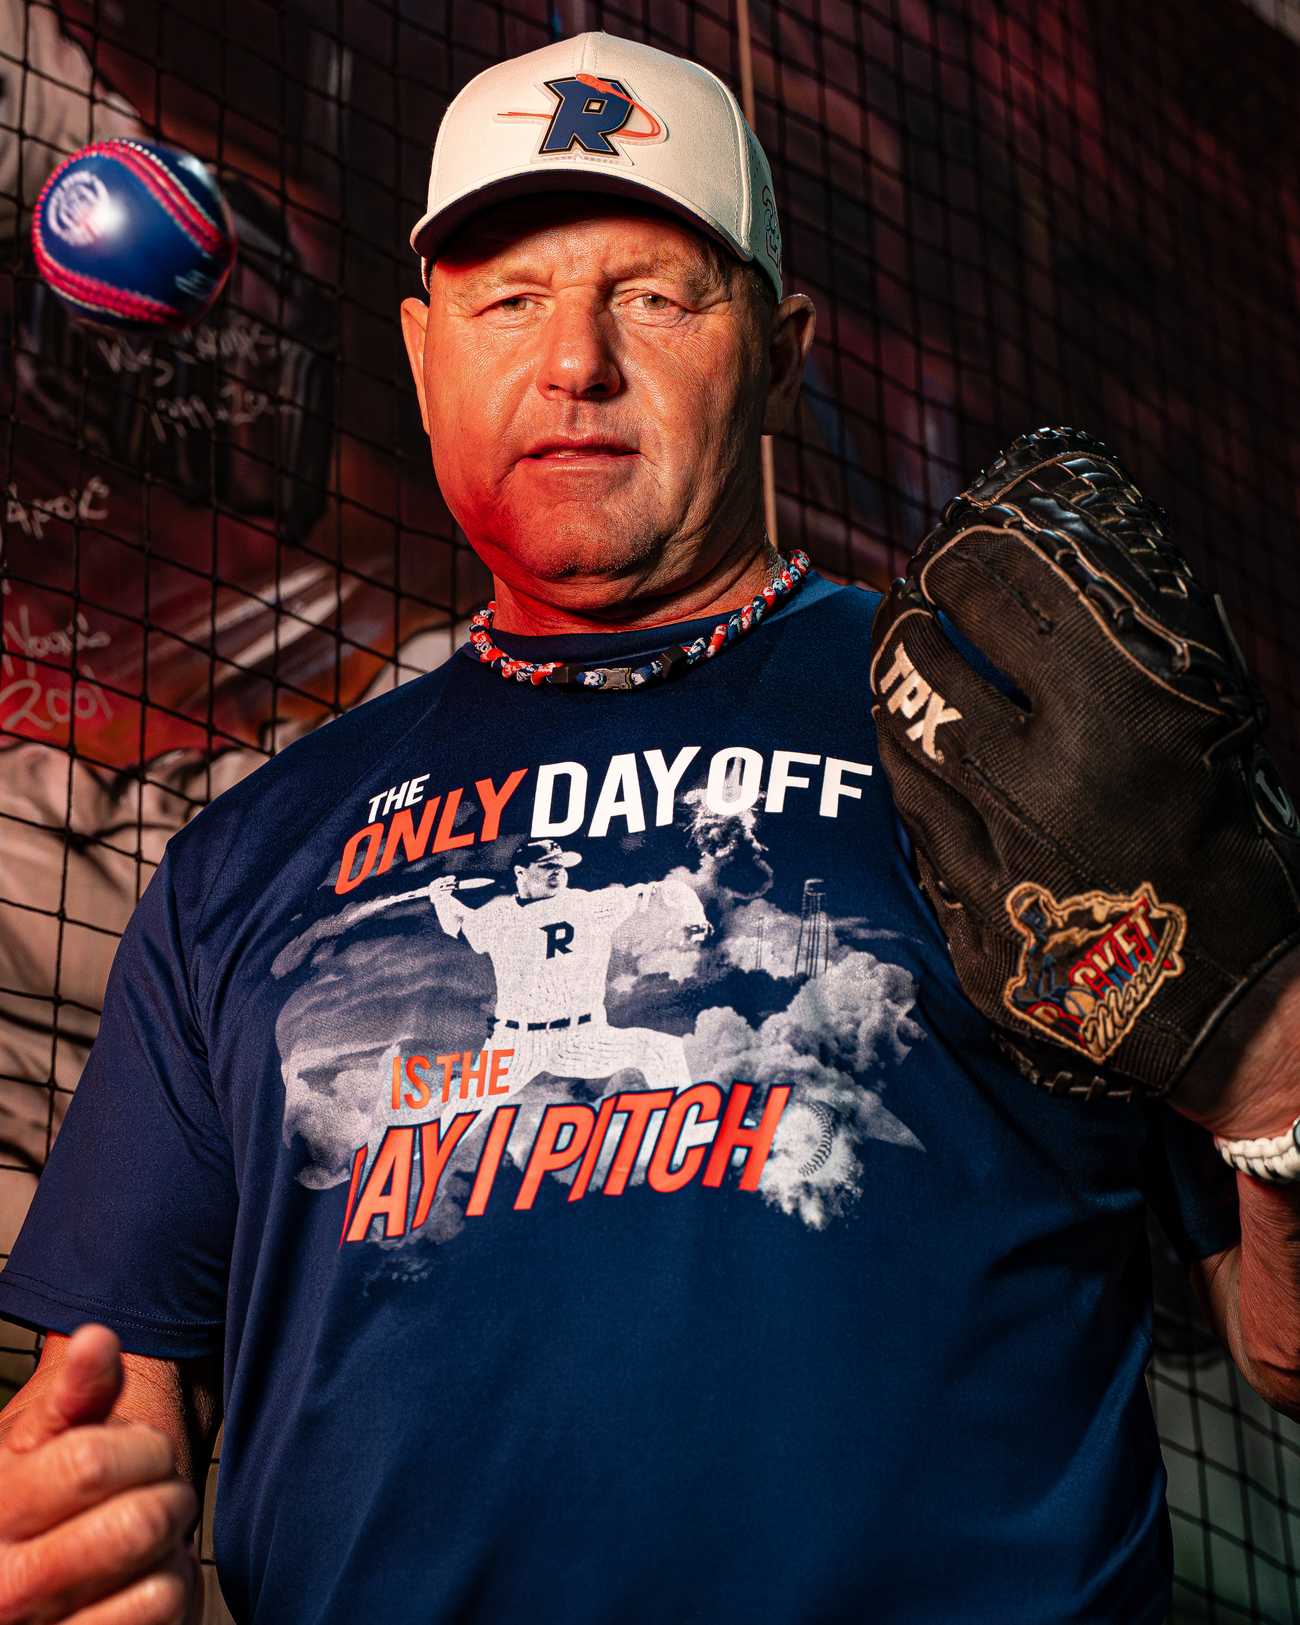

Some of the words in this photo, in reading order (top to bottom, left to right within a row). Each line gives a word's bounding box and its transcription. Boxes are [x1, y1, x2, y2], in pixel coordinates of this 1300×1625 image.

[538, 76, 635, 156] R
[879, 641, 963, 761] TPX
[334, 767, 529, 896] ONLY
[530, 746, 701, 838] DAY
[706, 746, 873, 818] OFF
[367, 773, 431, 824] THE
[538, 920, 575, 960] R
[1080, 959, 1153, 1053] Man
[391, 1056, 432, 1110] IS
[434, 1049, 515, 1104] THE
[338, 1109, 481, 1249] AY
[464, 1105, 518, 1217] I
[512, 1080, 796, 1211] PITCH
